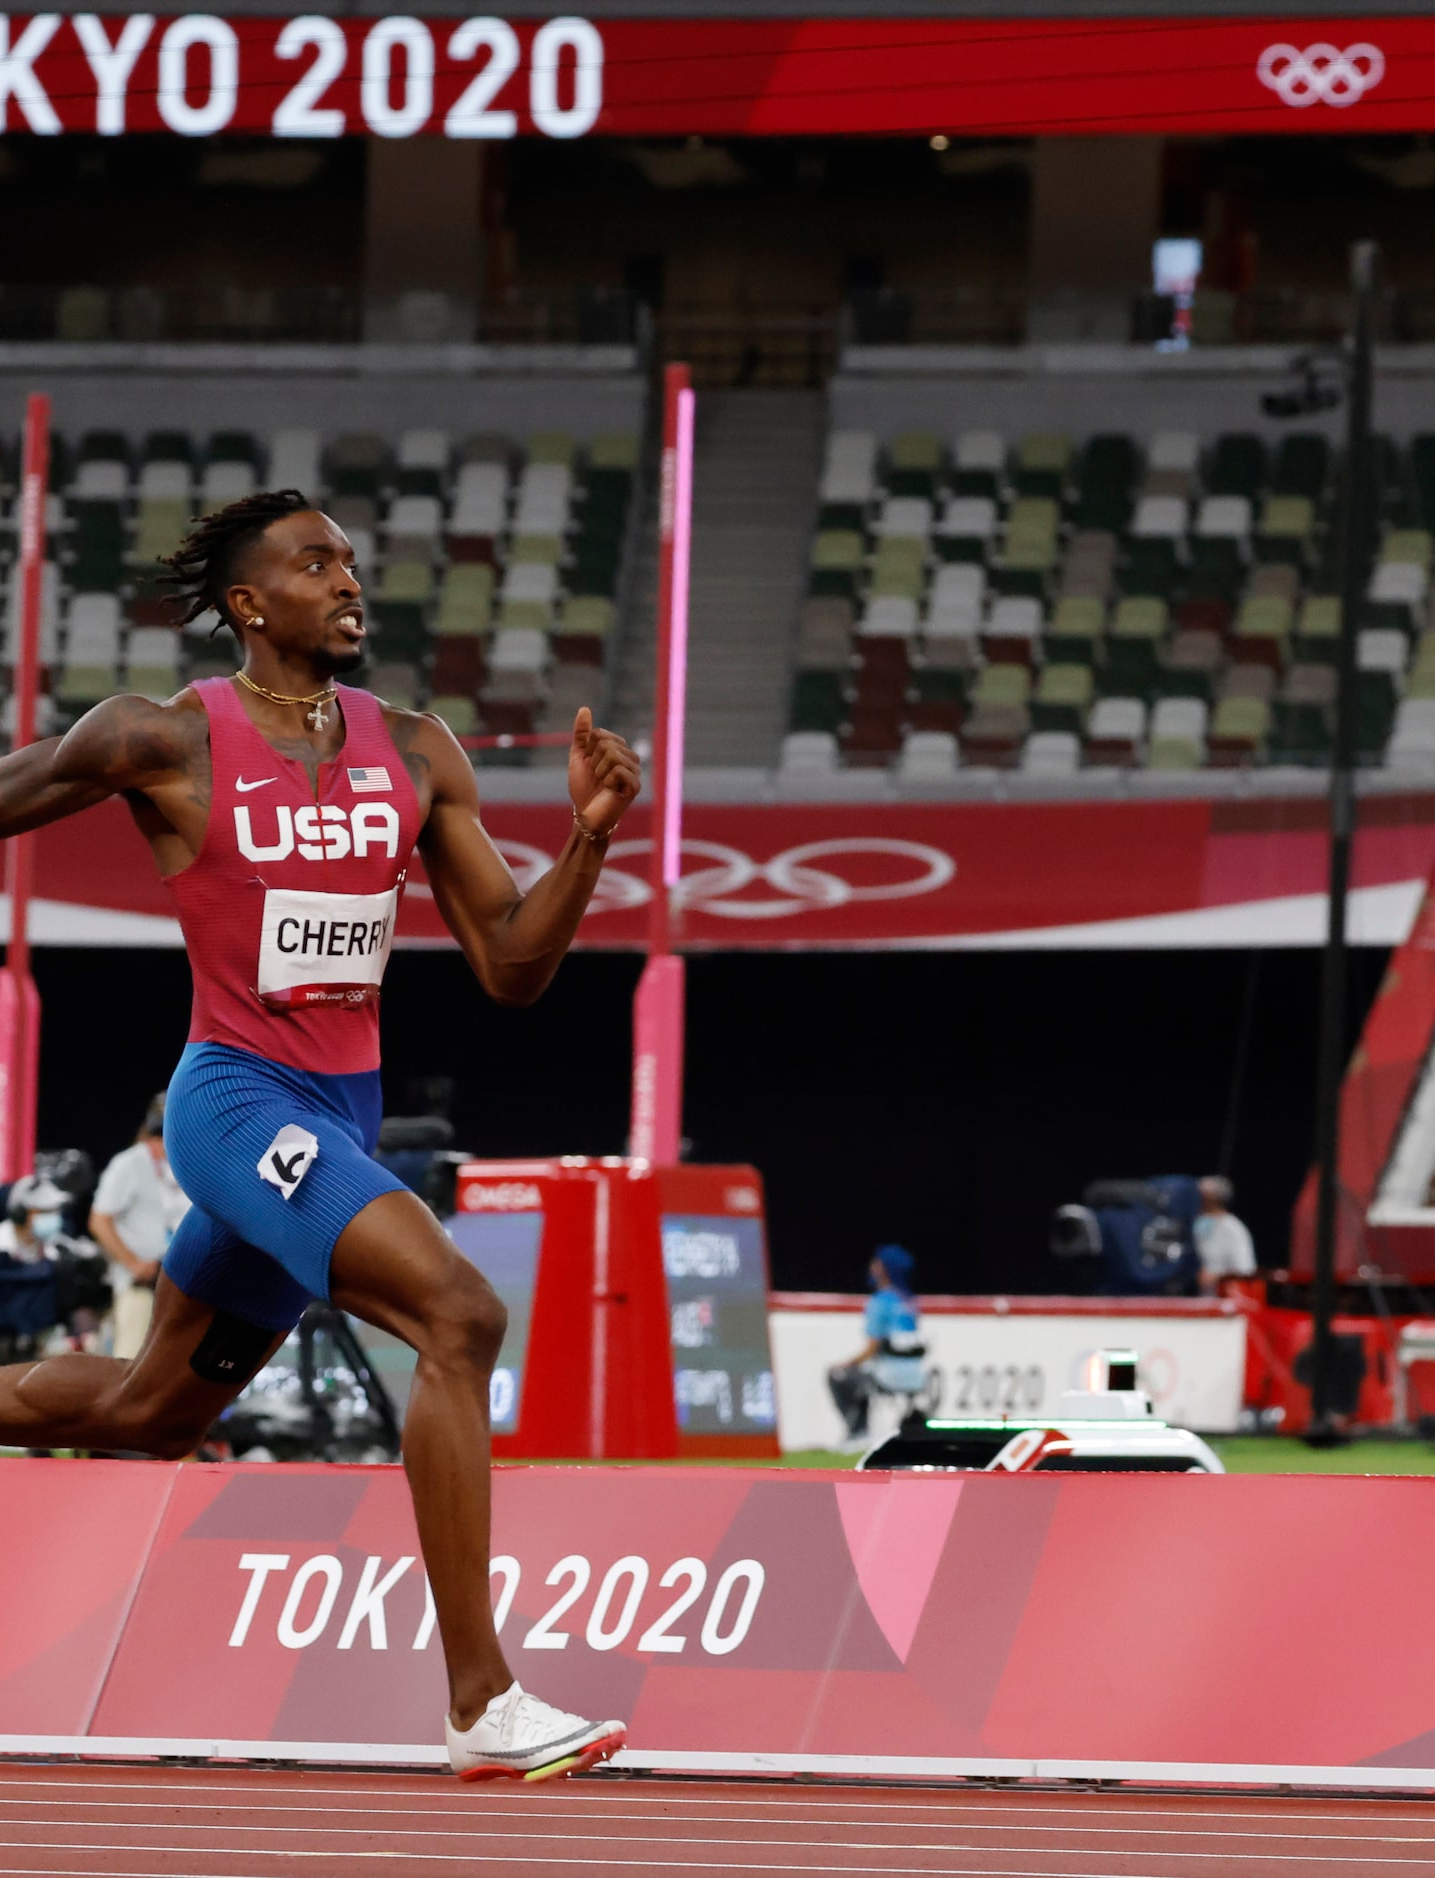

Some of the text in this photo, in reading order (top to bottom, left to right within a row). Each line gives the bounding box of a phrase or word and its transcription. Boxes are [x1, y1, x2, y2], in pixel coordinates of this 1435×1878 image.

[272, 14, 605, 140] 2020
[233, 802, 400, 863] USA
[277, 915, 390, 956] CHERRY
[522, 1554, 765, 1656] 2020
